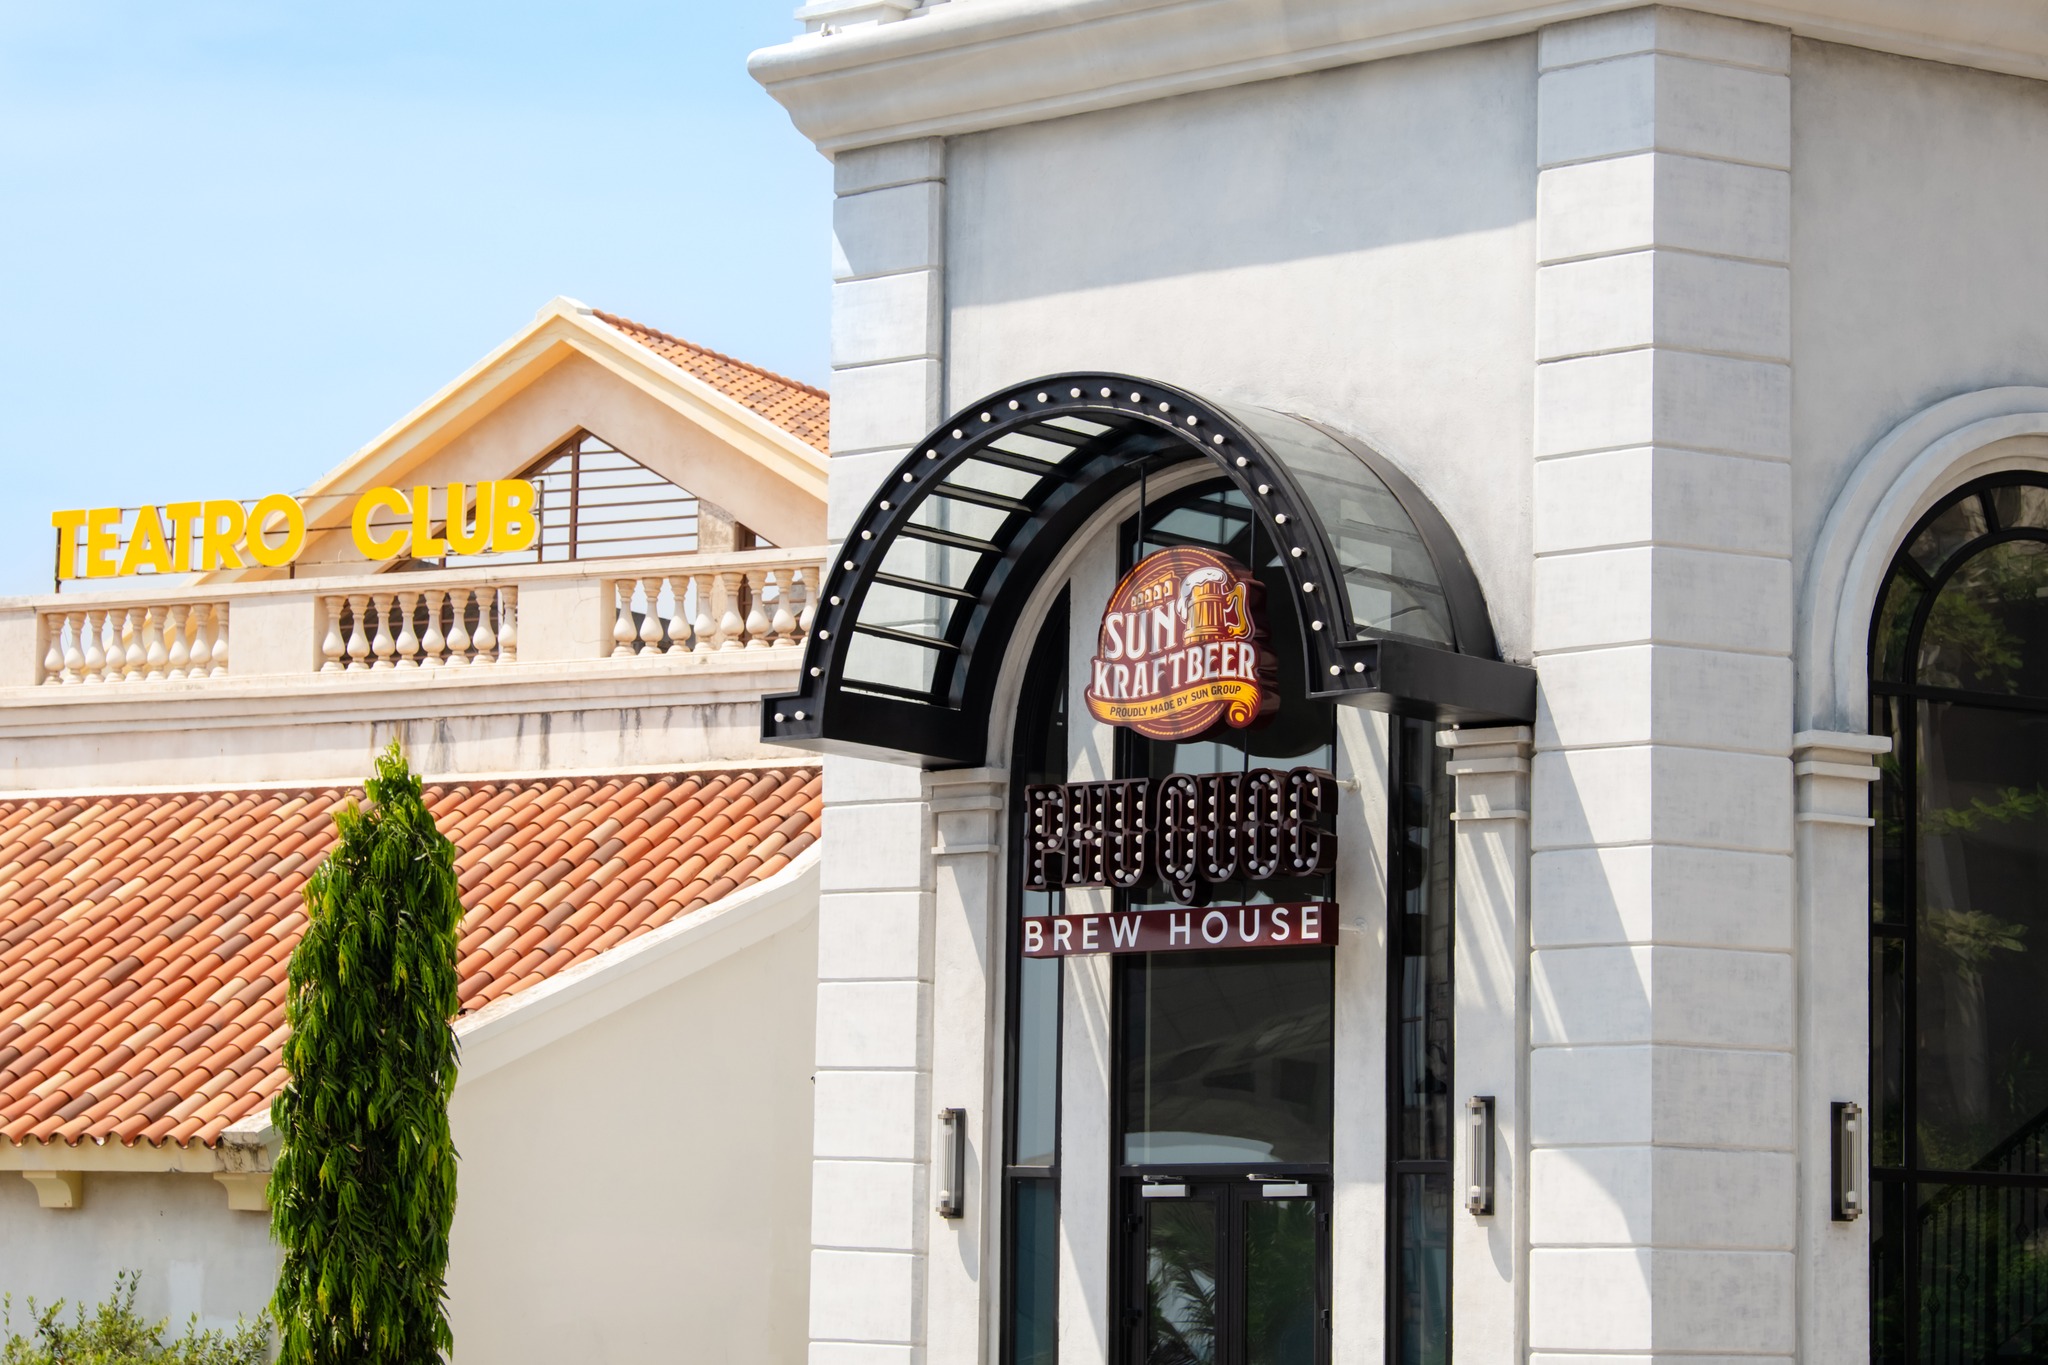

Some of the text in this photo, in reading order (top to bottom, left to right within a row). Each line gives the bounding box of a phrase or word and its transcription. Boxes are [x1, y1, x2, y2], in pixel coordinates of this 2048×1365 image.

[52, 479, 539, 579] TEATRO CLUB
[1105, 600, 1178, 660] SUN
[1093, 641, 1257, 699] KRAFTBEER
[1109, 684, 1241, 717] PROUDLY MADE BY SUN GROUP
[1025, 767, 1321, 905] PHU QUOC
[1024, 906, 1319, 952] BREW HOUSE
